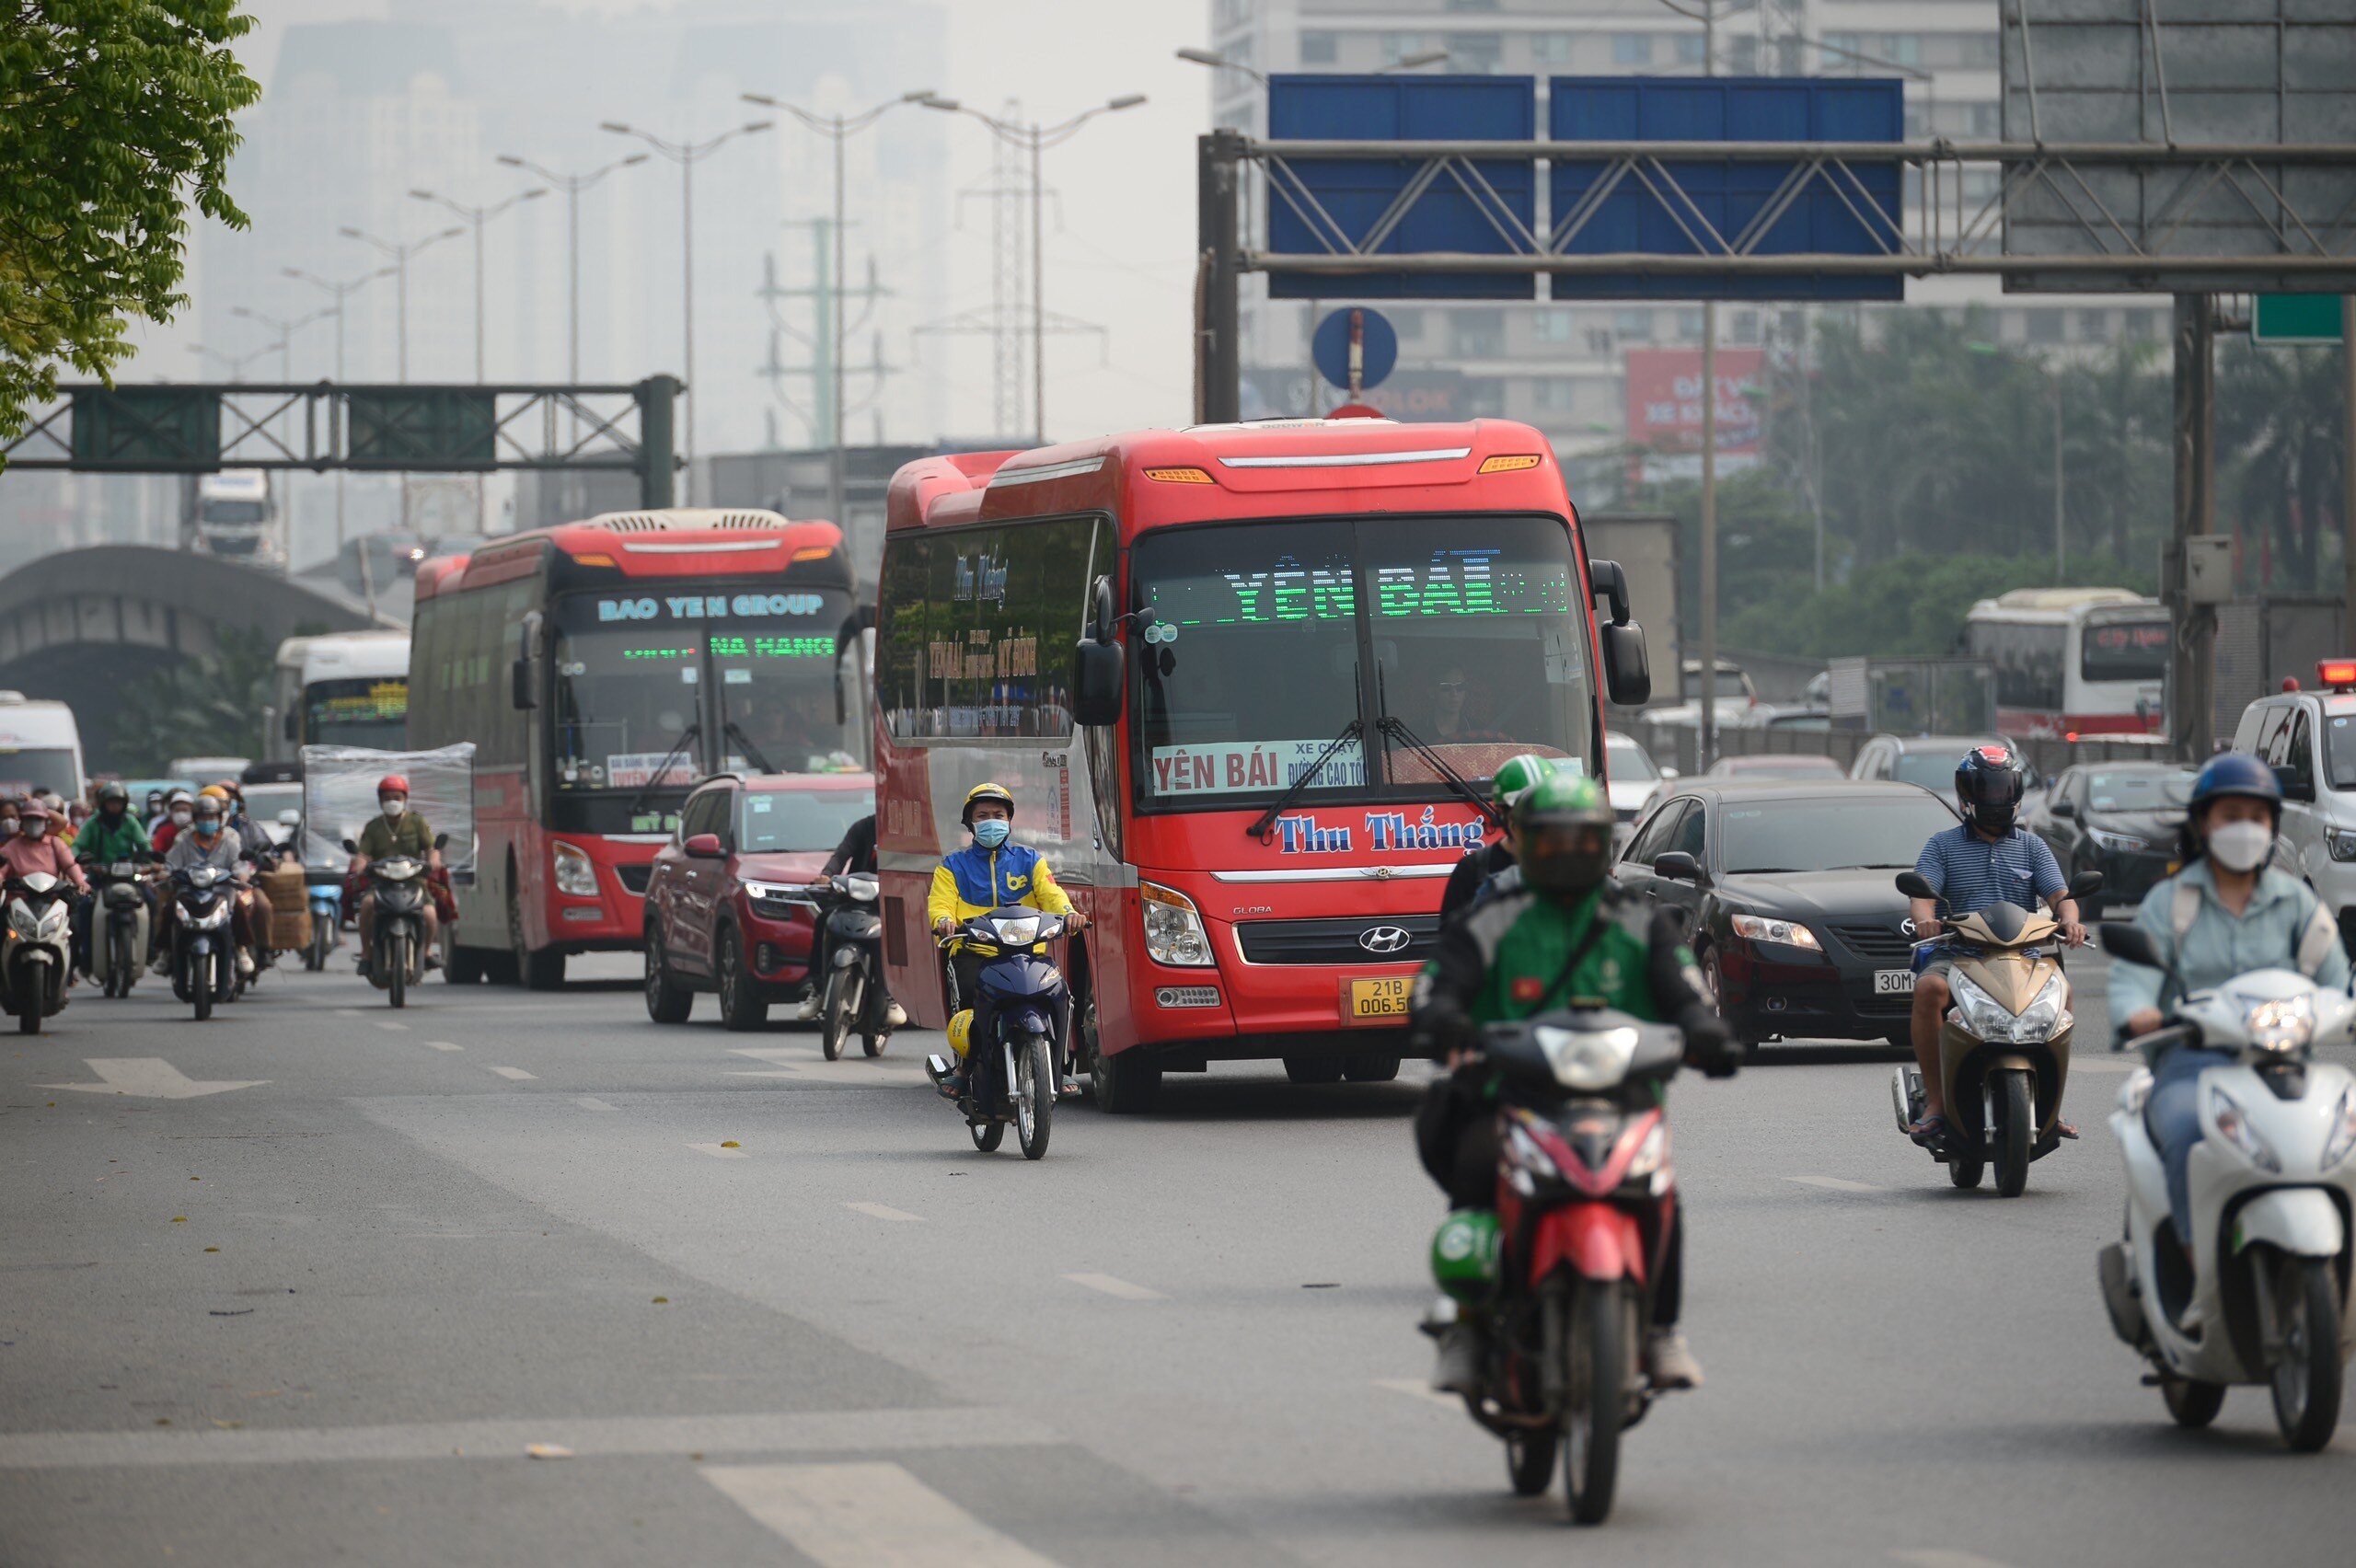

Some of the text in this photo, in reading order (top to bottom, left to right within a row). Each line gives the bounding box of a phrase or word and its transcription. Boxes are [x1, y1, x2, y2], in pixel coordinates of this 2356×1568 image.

[1224, 549, 1502, 620] YÊN BÁI
[598, 594, 823, 621] BAO YEN GROUP
[1296, 742, 1356, 755] XE CHẠY
[1155, 744, 1278, 791] YÊN BÁI
[1326, 763, 1346, 786] CAO
[1275, 805, 1485, 857] Thu Thắng
[1006, 871, 1028, 891] be
[1372, 981, 1403, 996] 21B
